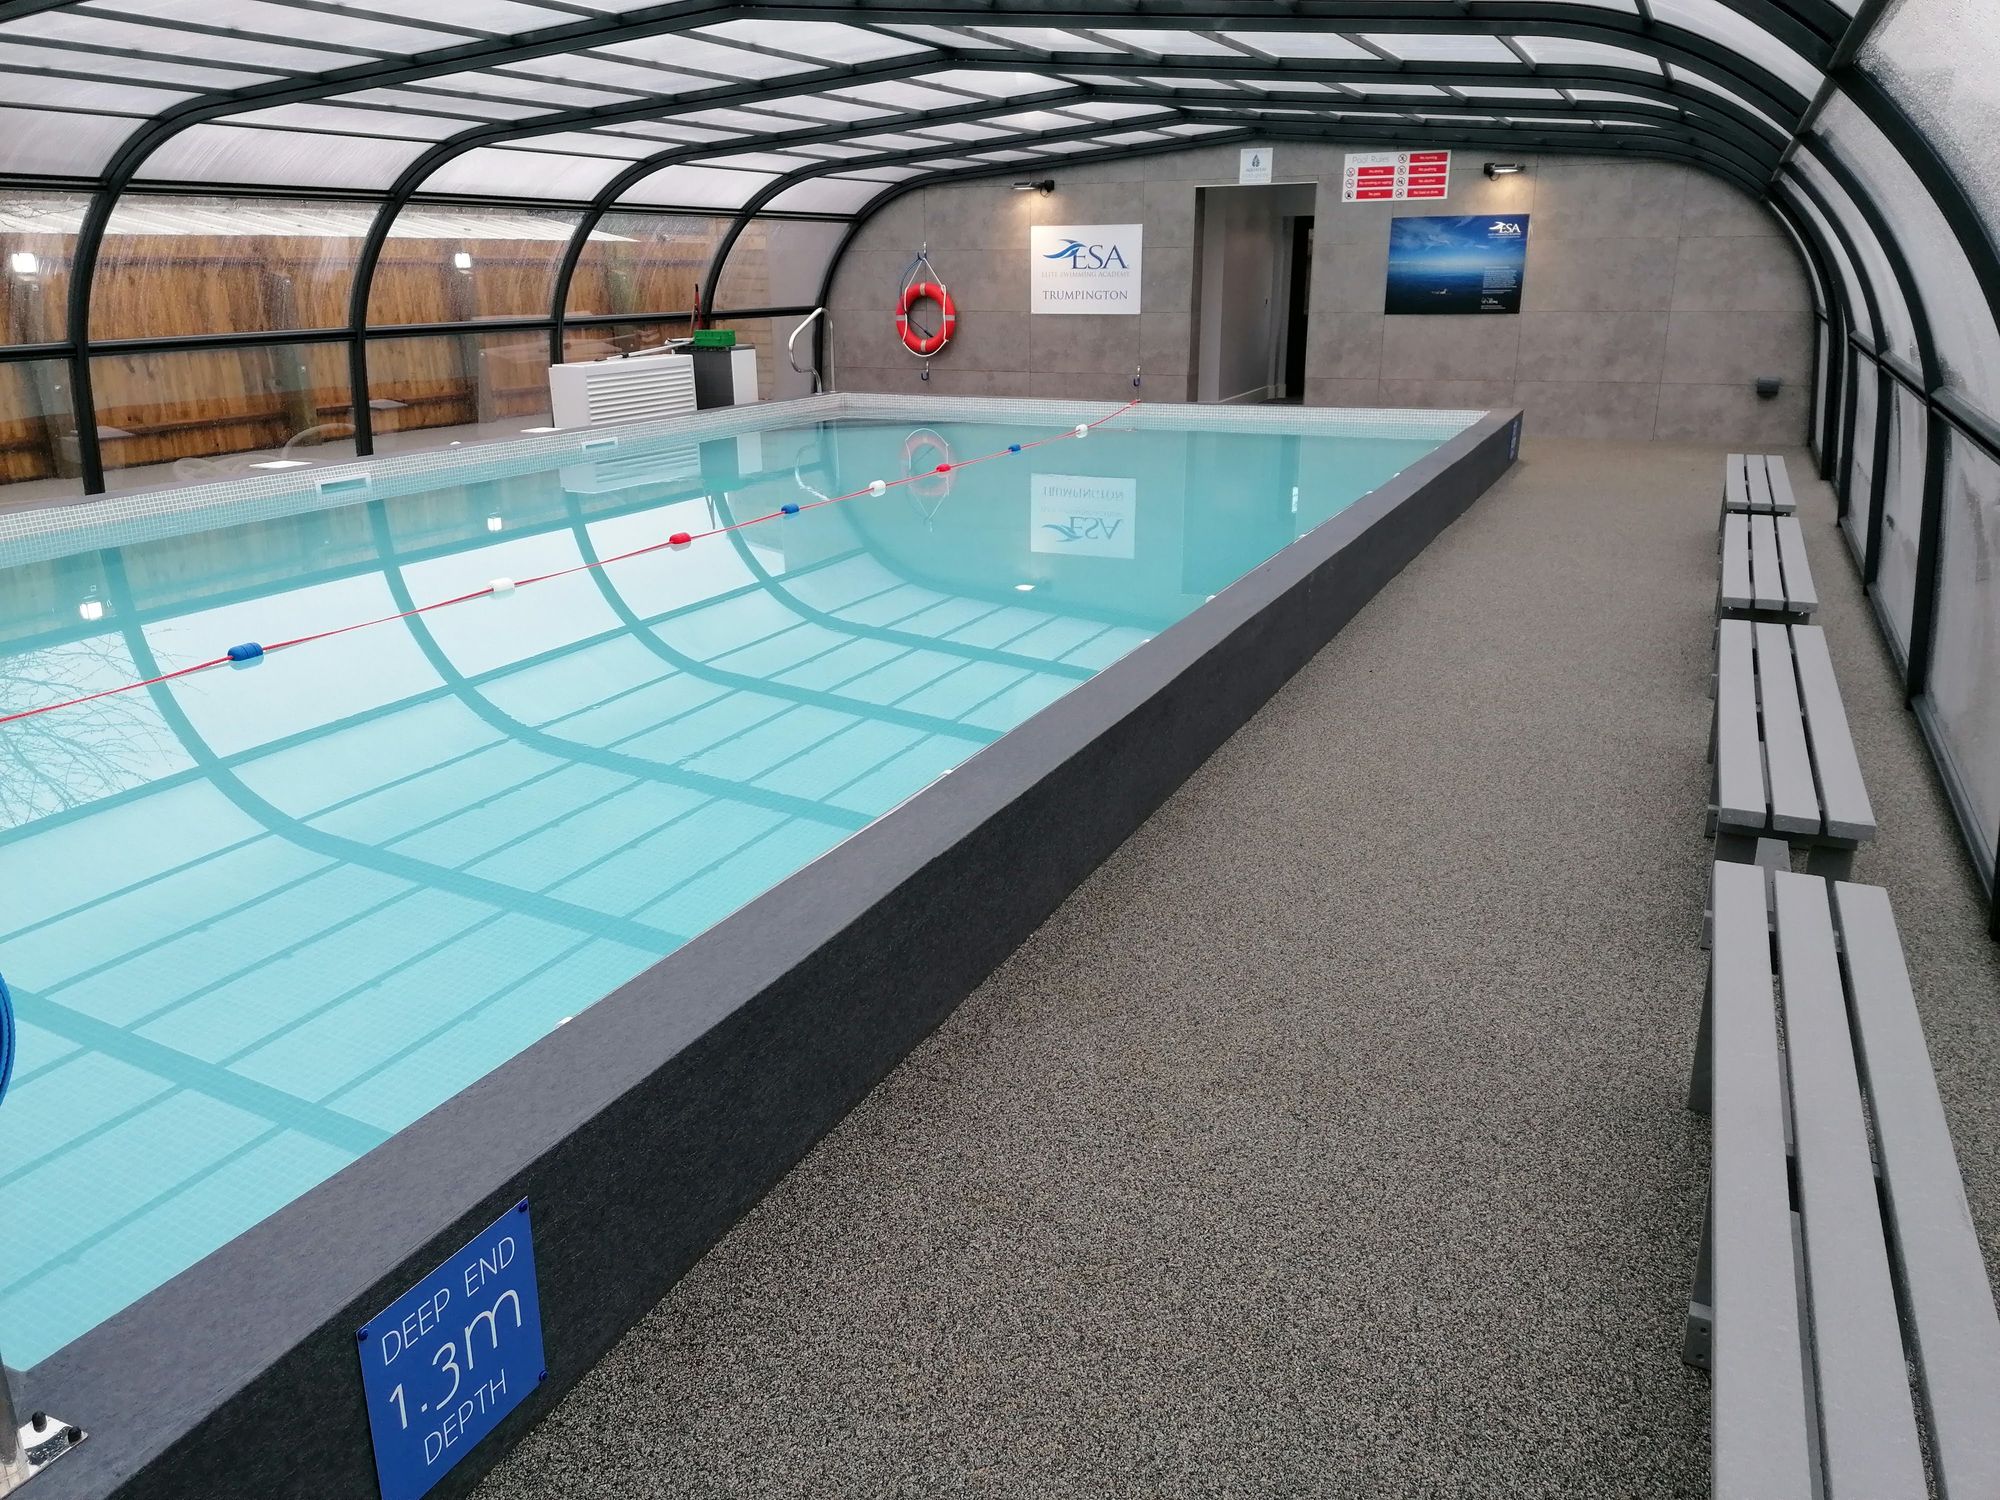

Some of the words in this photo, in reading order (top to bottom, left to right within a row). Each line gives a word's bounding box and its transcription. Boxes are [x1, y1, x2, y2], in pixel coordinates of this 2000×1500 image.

[1071, 244, 1129, 270] ESA
[1498, 223, 1521, 233] ESA
[1042, 290, 1128, 300] TRUMPINGTON
[381, 1287, 451, 1366] DEEP
[464, 1236, 516, 1298] END
[388, 1289, 522, 1430] 1.3m
[423, 1368, 508, 1466] DEPTH
